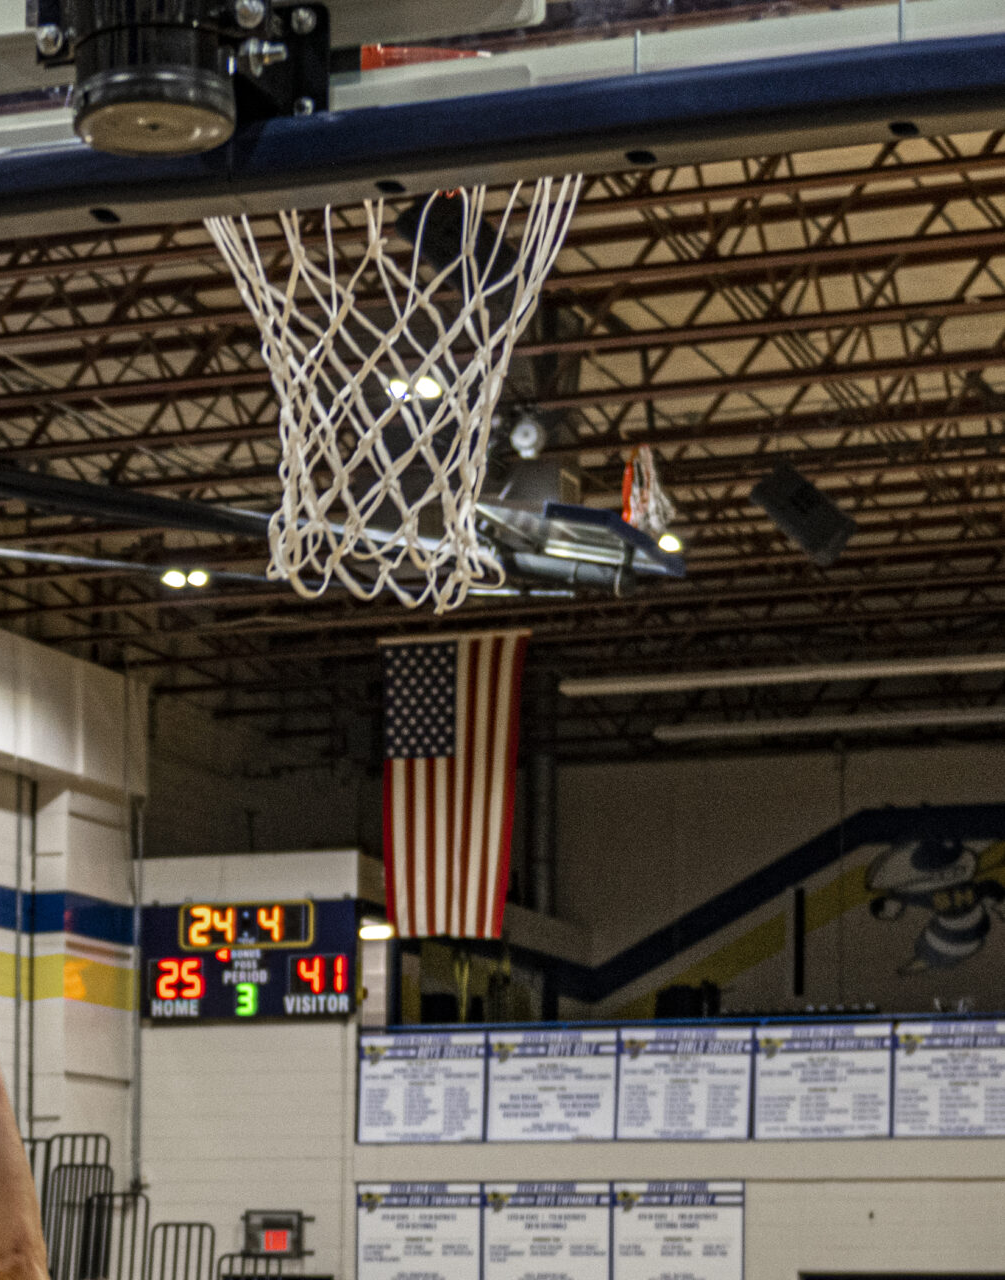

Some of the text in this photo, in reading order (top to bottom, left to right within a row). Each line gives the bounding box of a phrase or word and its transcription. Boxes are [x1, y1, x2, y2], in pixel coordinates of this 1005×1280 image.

[156, 955, 349, 1000] 25 41
[223, 969, 268, 984] PERIOD
[151, 994, 349, 1016] HOME VISITOR
[235, 982, 258, 1016] 3
